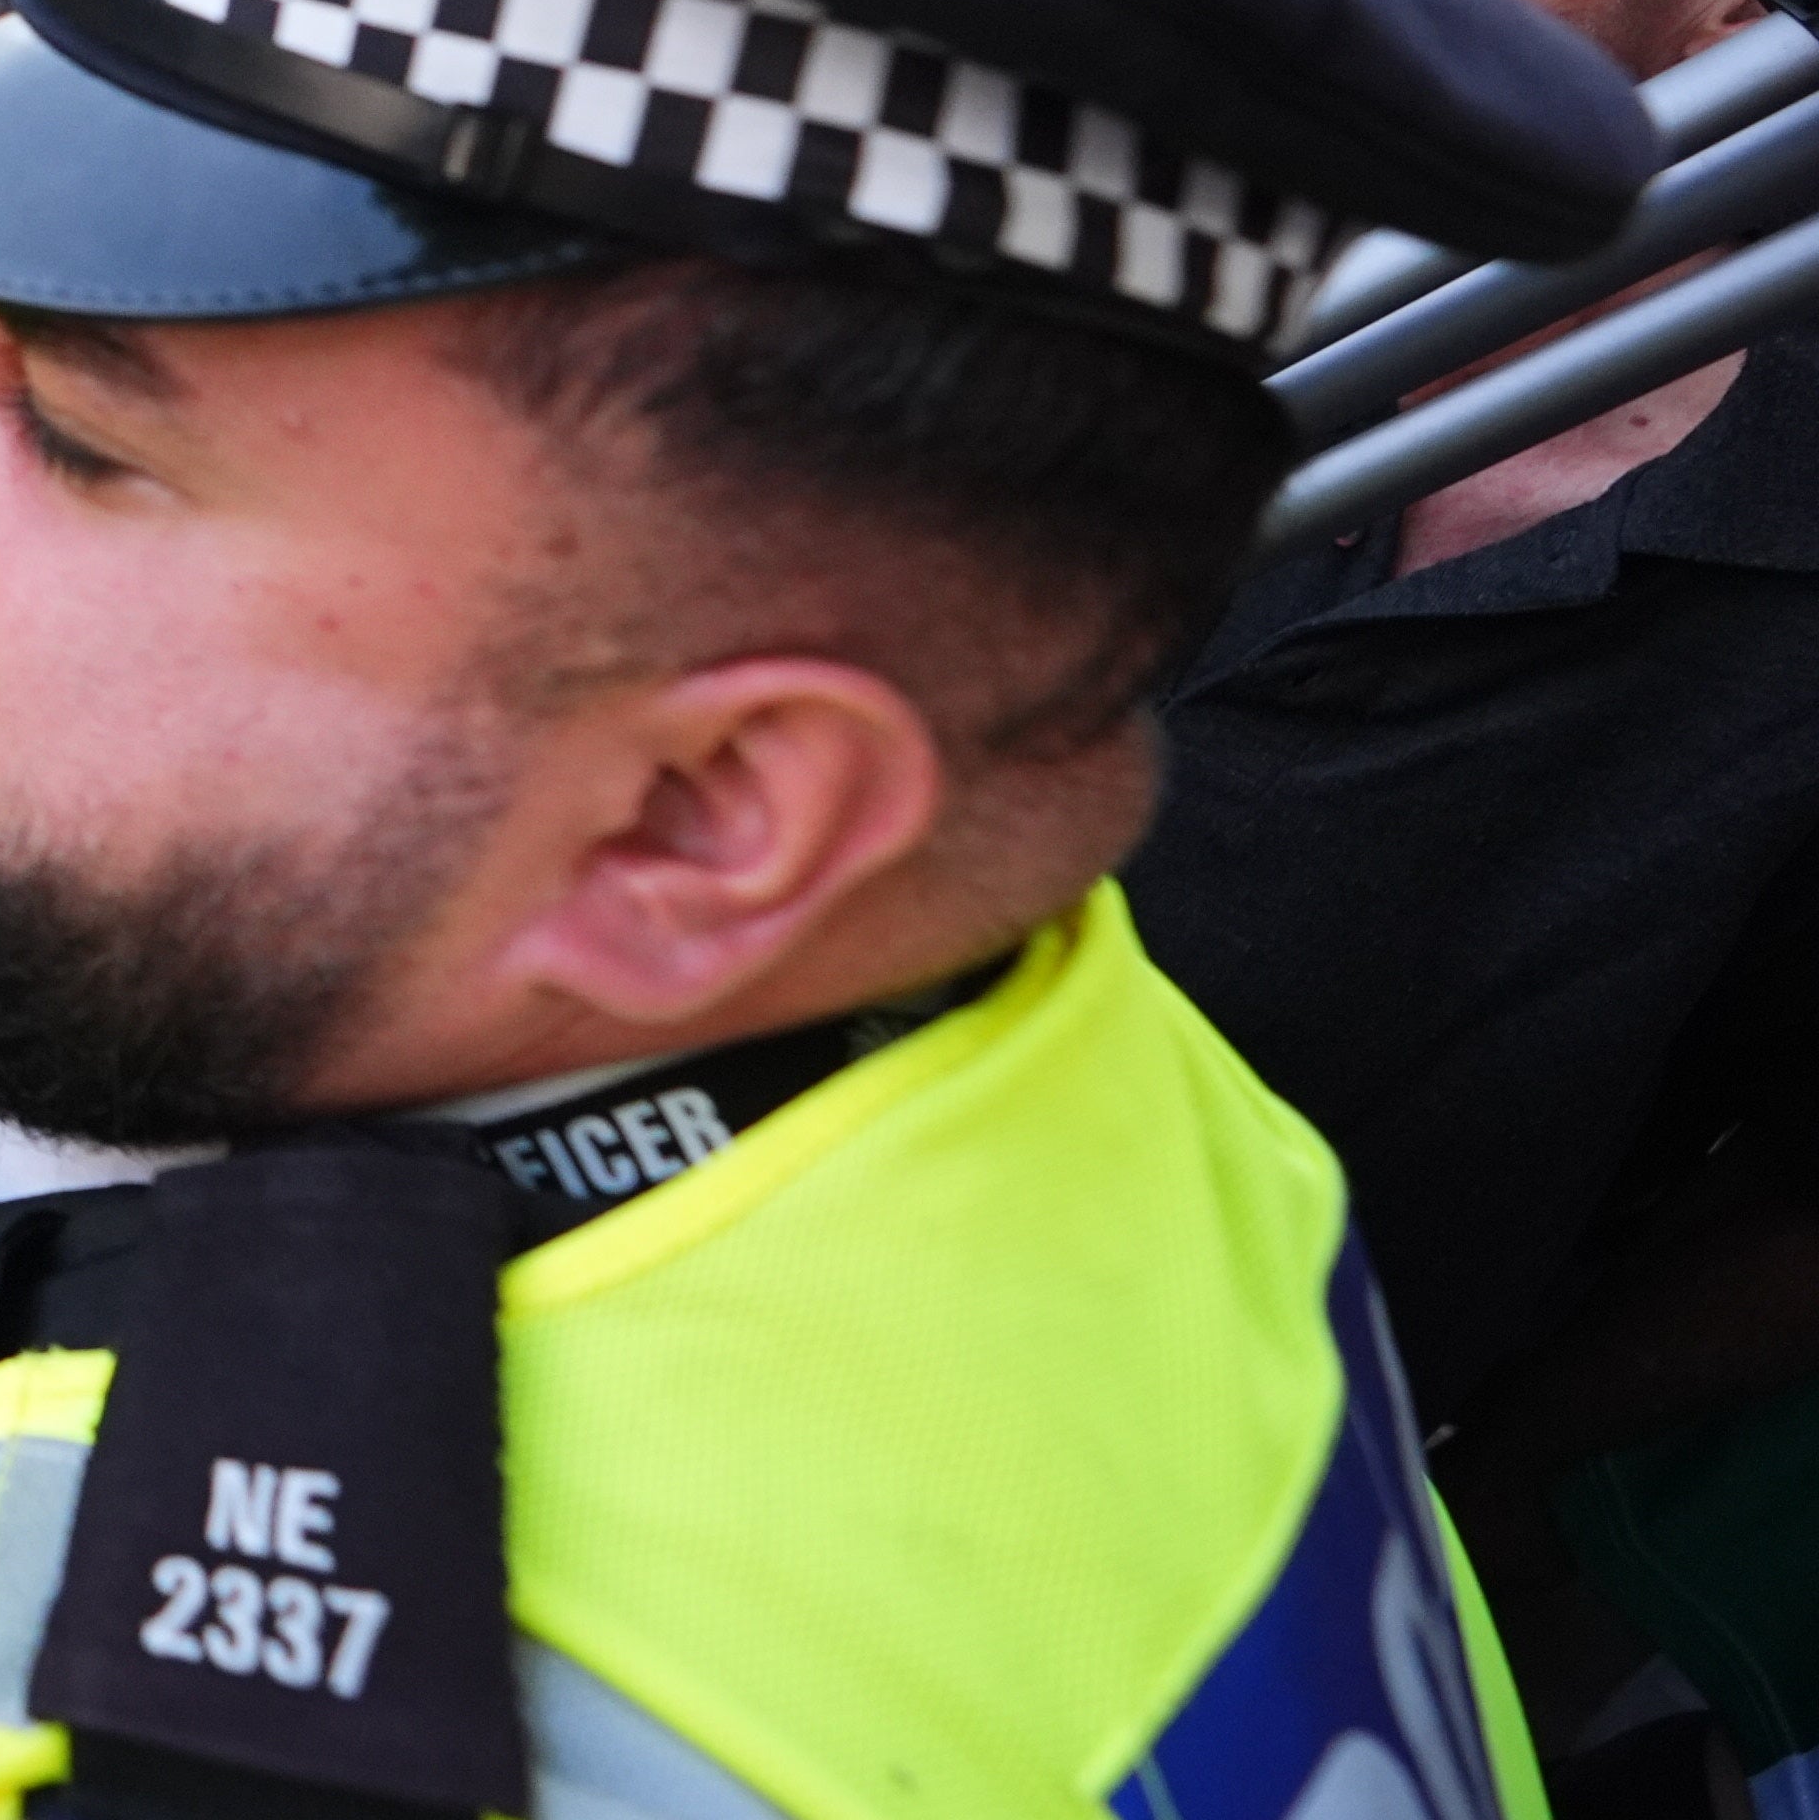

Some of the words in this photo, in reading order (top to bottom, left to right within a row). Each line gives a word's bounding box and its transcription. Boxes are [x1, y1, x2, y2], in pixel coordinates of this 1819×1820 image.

[491, 1085, 736, 1201] FICER
[205, 1456, 343, 1575] NE
[138, 1553, 394, 1702] 2337
